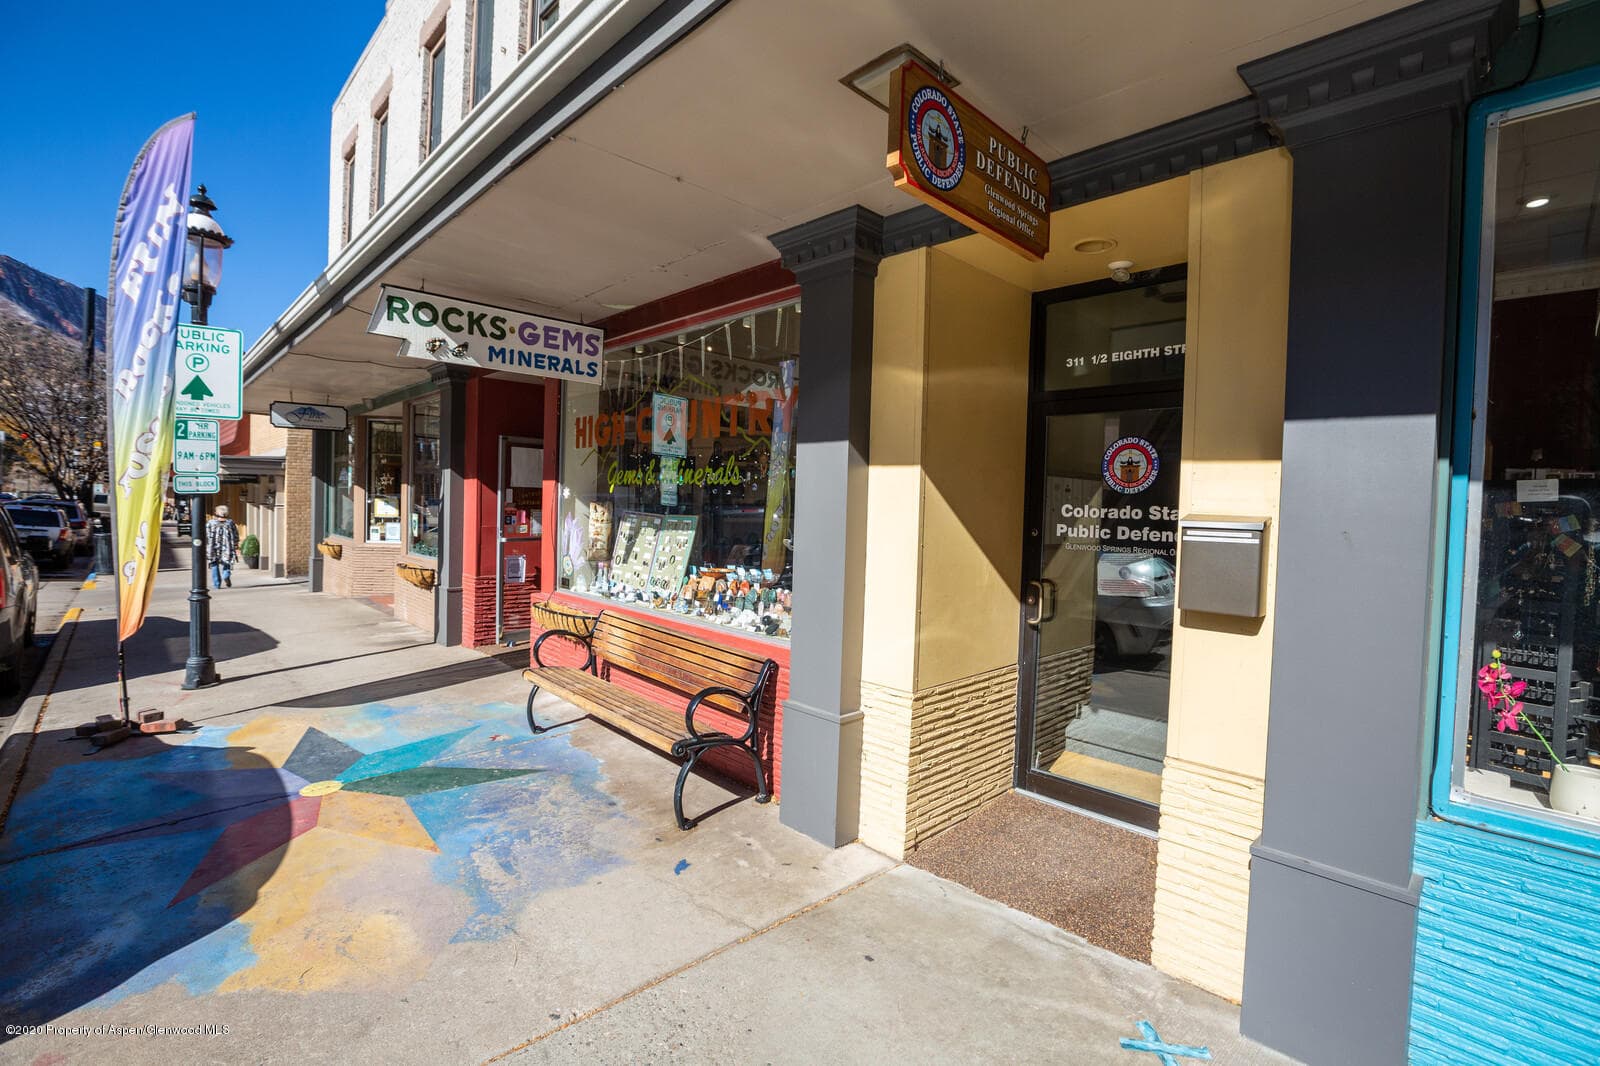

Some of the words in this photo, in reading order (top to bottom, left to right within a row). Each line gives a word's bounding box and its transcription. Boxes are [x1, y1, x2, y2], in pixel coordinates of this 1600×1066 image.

[911, 88, 947, 113] COLORADO
[947, 106, 964, 144] STATE
[910, 133, 931, 178] PUBLIC
[931, 161, 964, 190] DEFENDER
[989, 135, 1038, 185] PUBLIC
[976, 149, 1046, 213] DEFENDER
[984, 183, 1016, 211] Glenwood
[1017, 207, 1038, 226] Springs
[988, 200, 1016, 224] Regional
[1016, 220, 1035, 238] Office
[180, 329, 225, 343] UBLIC
[386, 295, 507, 340] ROCKS
[518, 321, 601, 357] GEMS
[176, 340, 230, 354] ARKING
[1066, 356, 1084, 368] 311
[1091, 353, 1108, 365] 1/2
[1111, 347, 1160, 362] EIGHTH
[487, 345, 599, 378] MINERALS
[177, 422, 186, 437] 2
[575, 411, 625, 449] HIGH
[637, 384, 799, 444] COUNTRY
[189, 431, 216, 439] PARKING
[1104, 437, 1139, 460] COLORADO
[1139, 438, 1159, 460] STATE
[607, 460, 643, 494] Gems
[645, 458, 656, 485] &
[1103, 471, 1124, 492] PUBLIC
[1124, 470, 1159, 494] DEFENDER
[1061, 503, 1143, 520] Colorado
[1056, 523, 1111, 540] Public
[1116, 526, 1178, 543] Defen
[1064, 542, 1102, 552] GLENWOOD
[1102, 544, 1132, 555] SPRINGS
[1132, 546, 1169, 557] REGIONAL
